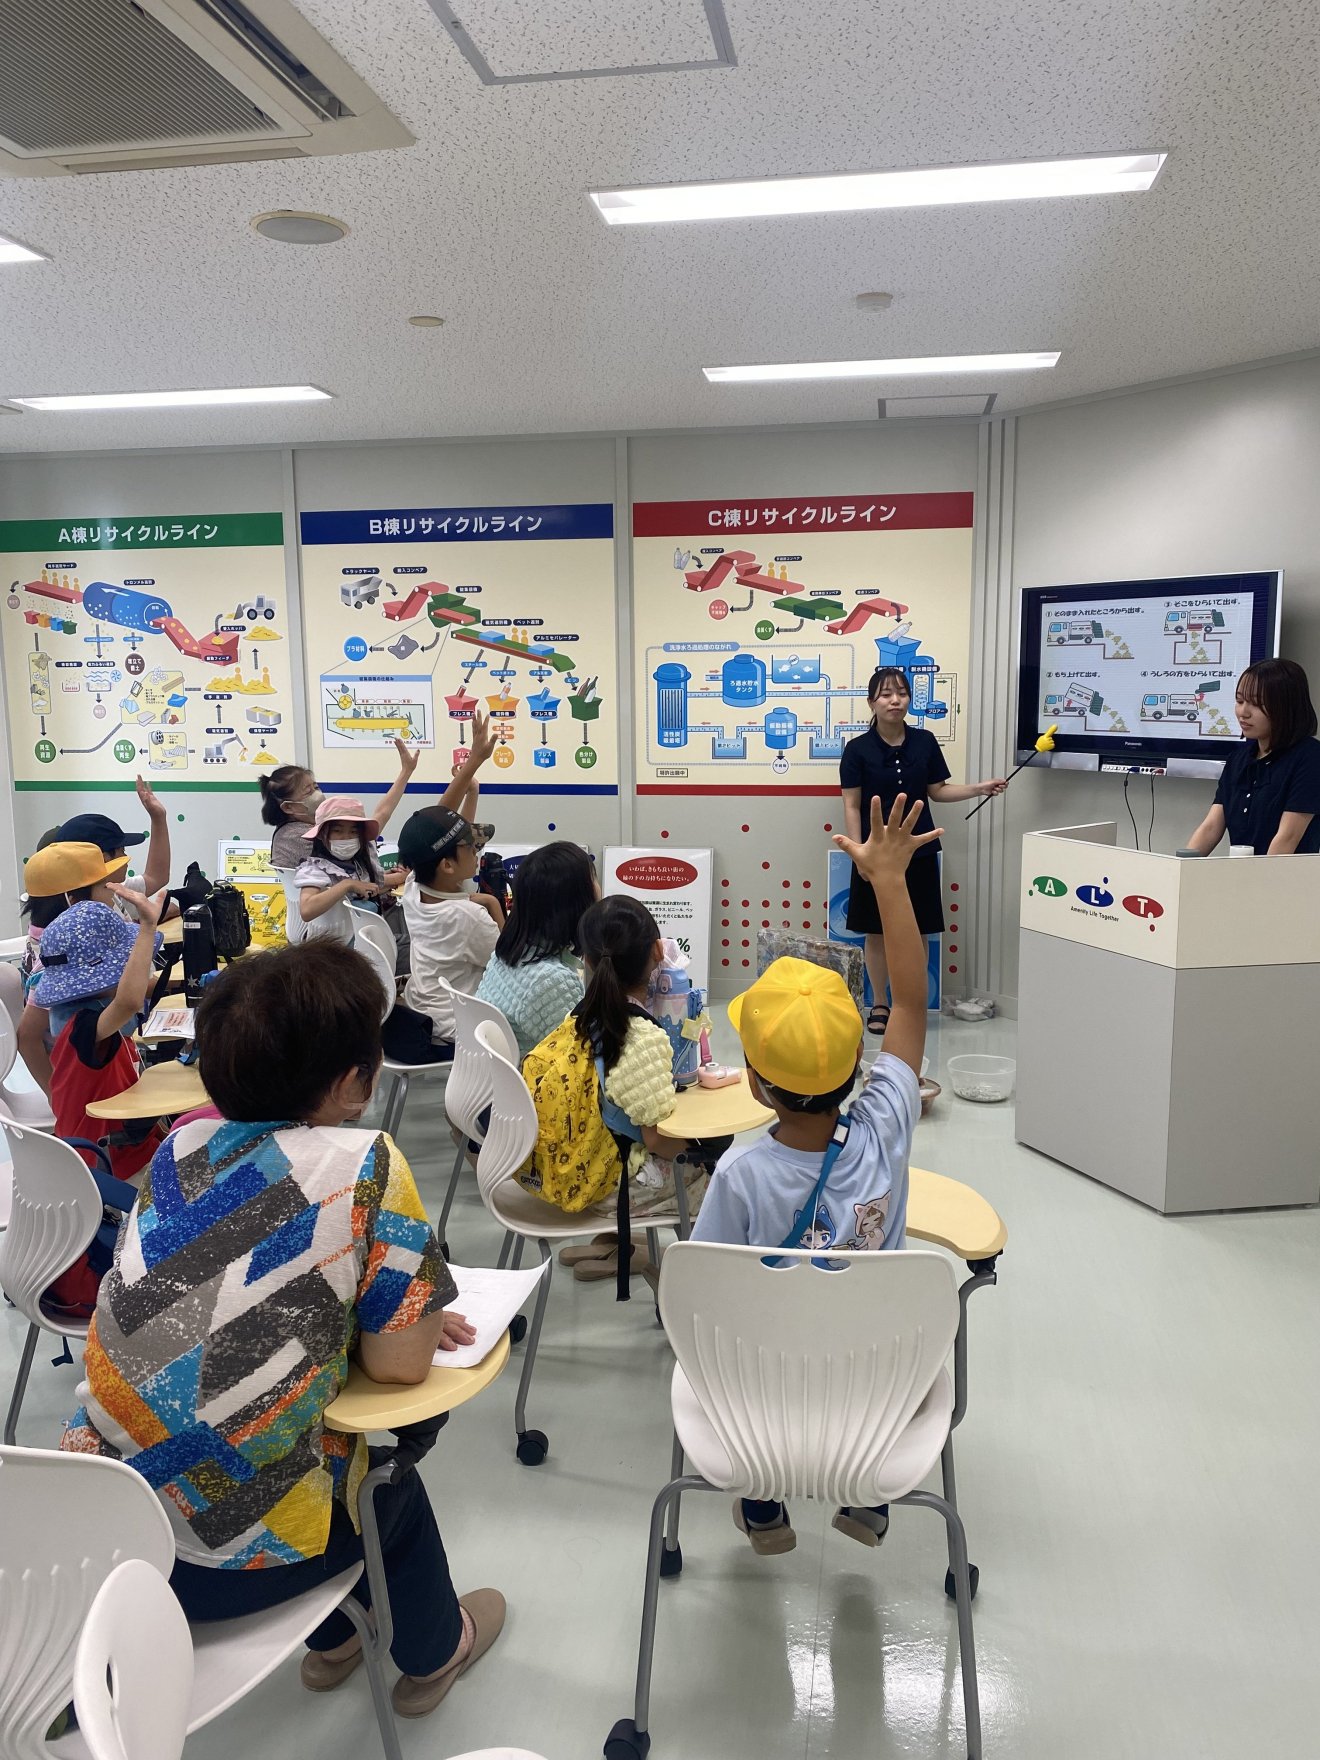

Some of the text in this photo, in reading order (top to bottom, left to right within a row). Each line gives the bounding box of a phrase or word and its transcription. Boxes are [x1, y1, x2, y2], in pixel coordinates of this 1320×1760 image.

[707, 504, 897, 528] C棟リサイクルライン
[369, 515, 543, 536] B棟リサイクルライン
[58, 524, 218, 544] A棟リサイクルライン
[1174, 599, 1241, 608] そこをひらいて出す。
[1054, 607, 1145, 617] そのまま入れたところから出す。
[1150, 670, 1237, 678] うしろの方をひらいて出す。
[1044, 879, 1148, 914] A L T
[1099, 912, 1119, 922] Together
